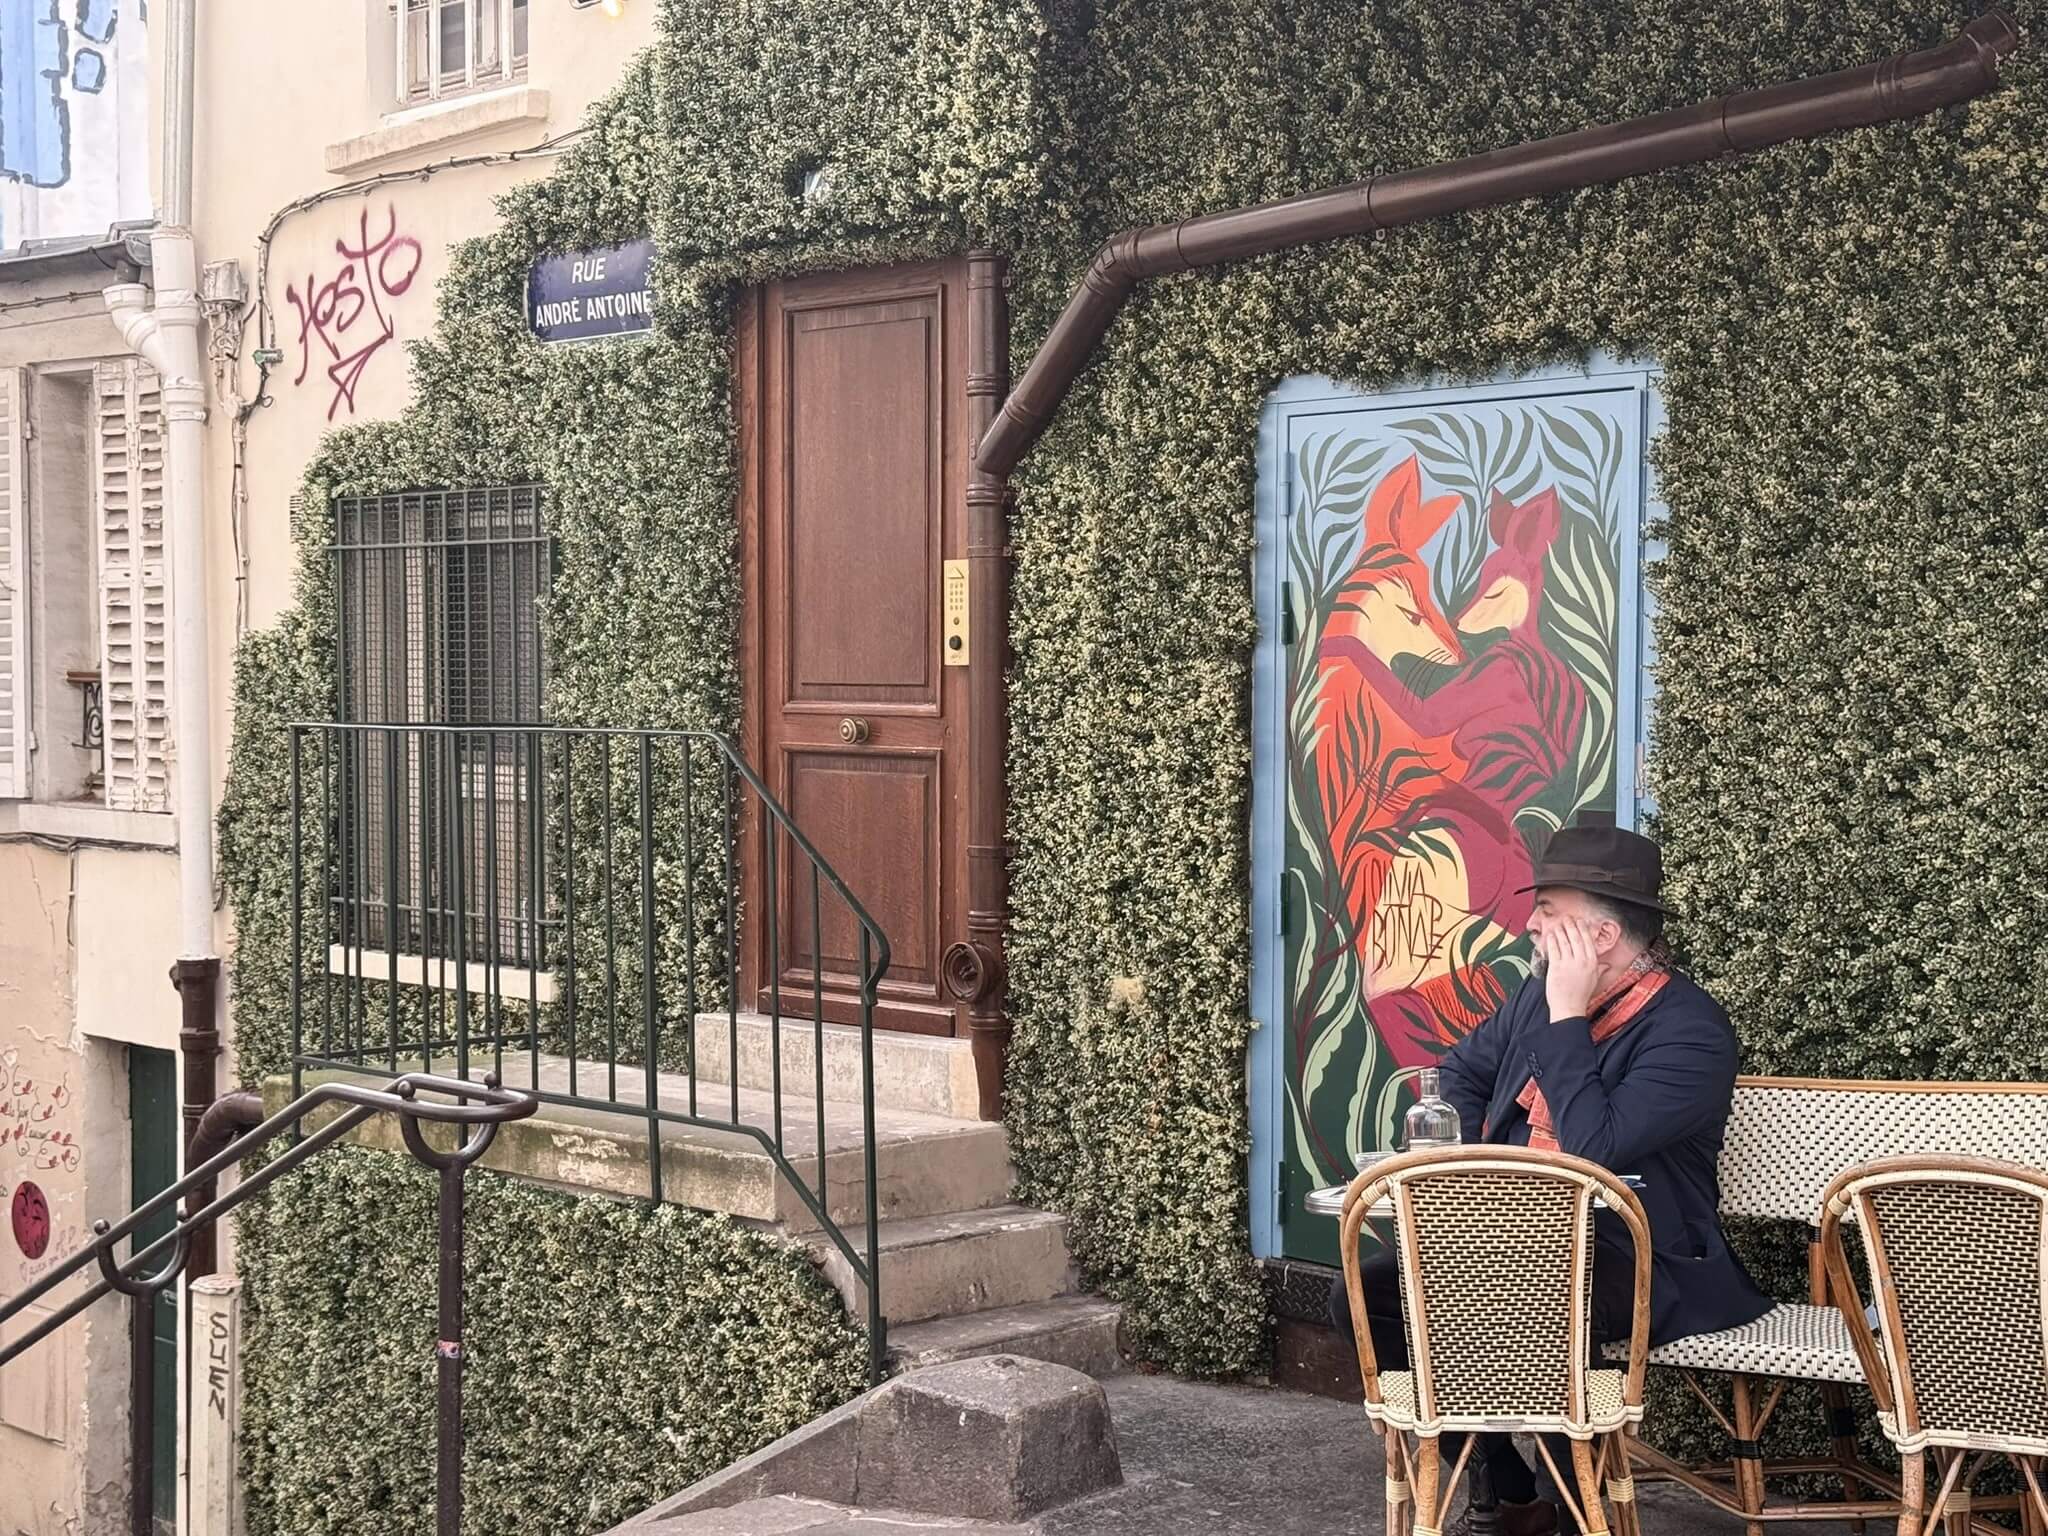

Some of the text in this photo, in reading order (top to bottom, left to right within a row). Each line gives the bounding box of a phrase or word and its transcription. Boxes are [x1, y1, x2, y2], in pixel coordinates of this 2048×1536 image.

[572, 257, 606, 284] RUE
[535, 290, 653, 328] ANDRÉ ANTOINE
